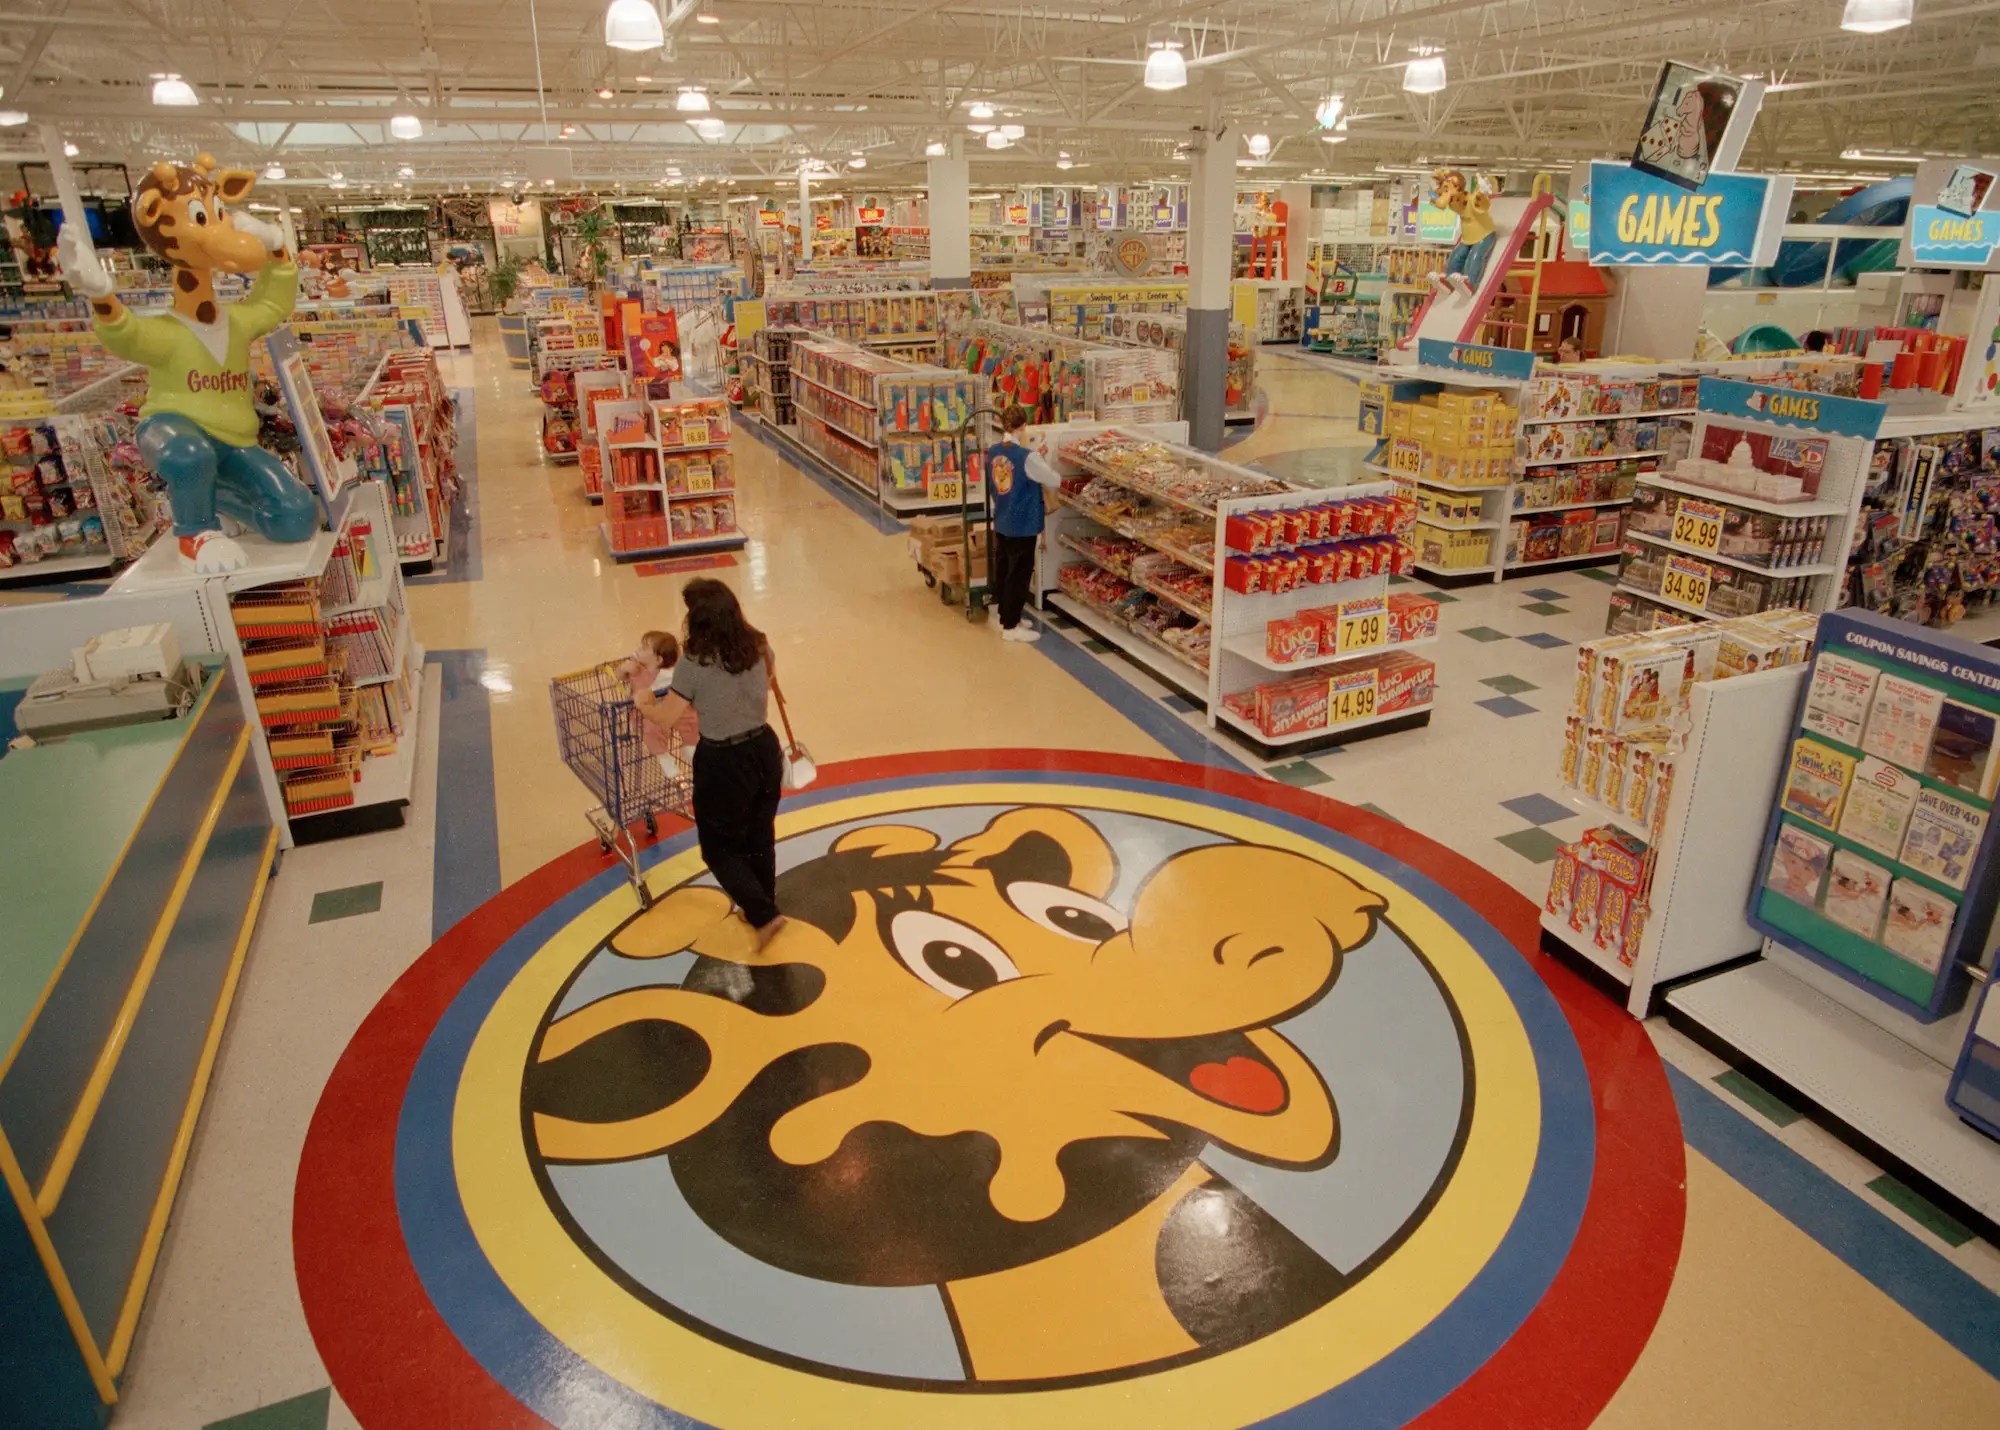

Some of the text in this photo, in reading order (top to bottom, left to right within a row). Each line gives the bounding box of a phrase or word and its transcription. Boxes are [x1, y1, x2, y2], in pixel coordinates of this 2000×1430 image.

[1617, 191, 1723, 249] GAMES
[1929, 218, 1984, 242] GAMES
[578, 333, 599, 347] 9.99
[1463, 350, 1494, 368] GAMES
[1769, 393, 1820, 420] GAMES
[1394, 450, 1419, 472] 14.99
[933, 483, 957, 499] 4.99
[1675, 515, 1718, 548] 32.99
[1665, 571, 1706, 604] 34.99
[1346, 616, 1380, 648] 7.99
[1404, 606, 1434, 633] UNO
[1280, 626, 1314, 655] UNO
[1846, 631, 1895, 655] COUPON
[1896, 648, 1948, 673] SAVINGS
[1952, 665, 2000, 690] CENTER
[1380, 672, 1402, 691] UNO
[1332, 688, 1374, 721] 14.99
[1918, 792, 1939, 807] SAVE
[1940, 799, 1961, 819] OVER
